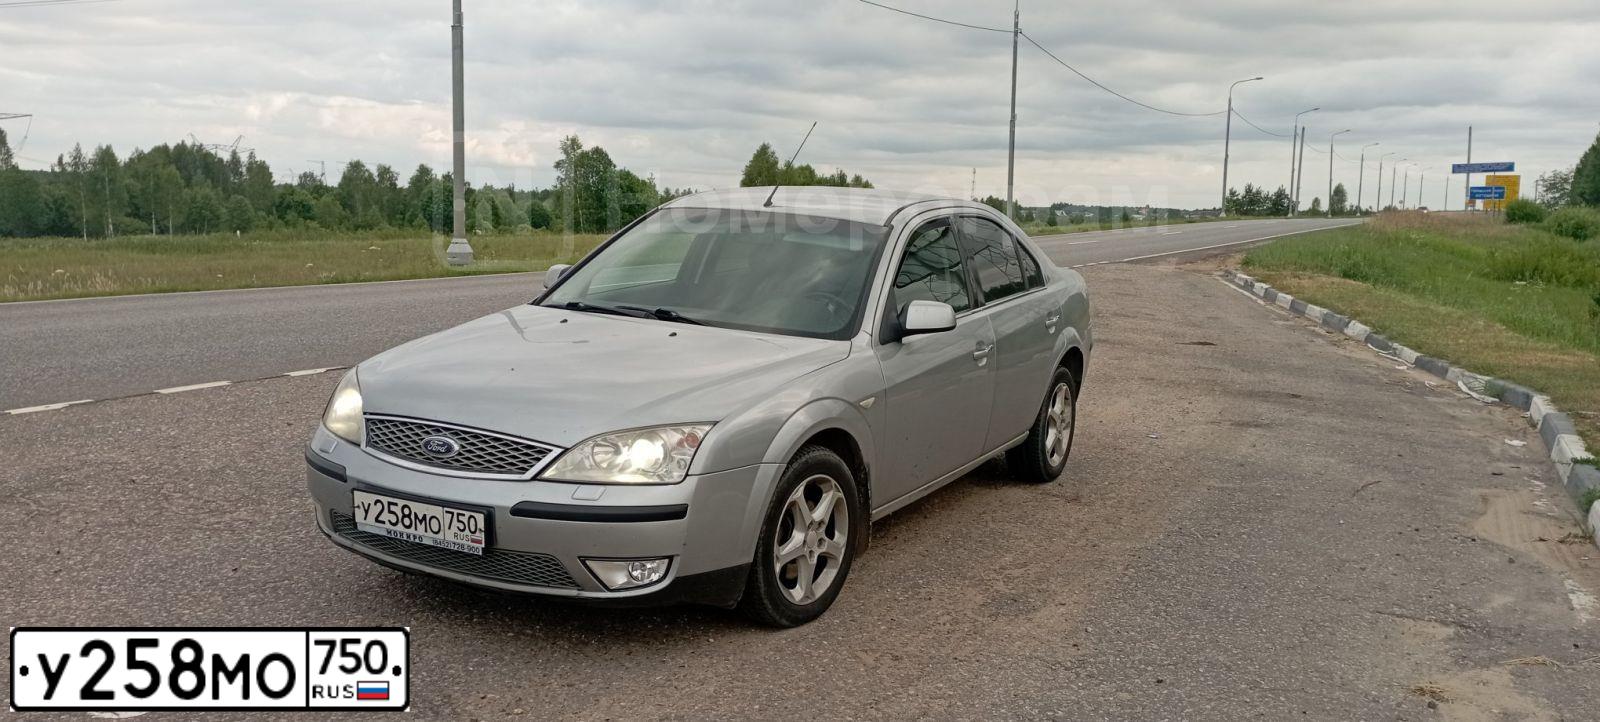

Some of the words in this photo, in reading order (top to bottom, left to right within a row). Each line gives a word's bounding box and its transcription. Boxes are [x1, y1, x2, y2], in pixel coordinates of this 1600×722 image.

[427, 440, 448, 452] Ford
[361, 498, 441, 535] У258МО
[445, 510, 478, 534] 750
[453, 532, 470, 542] RUS
